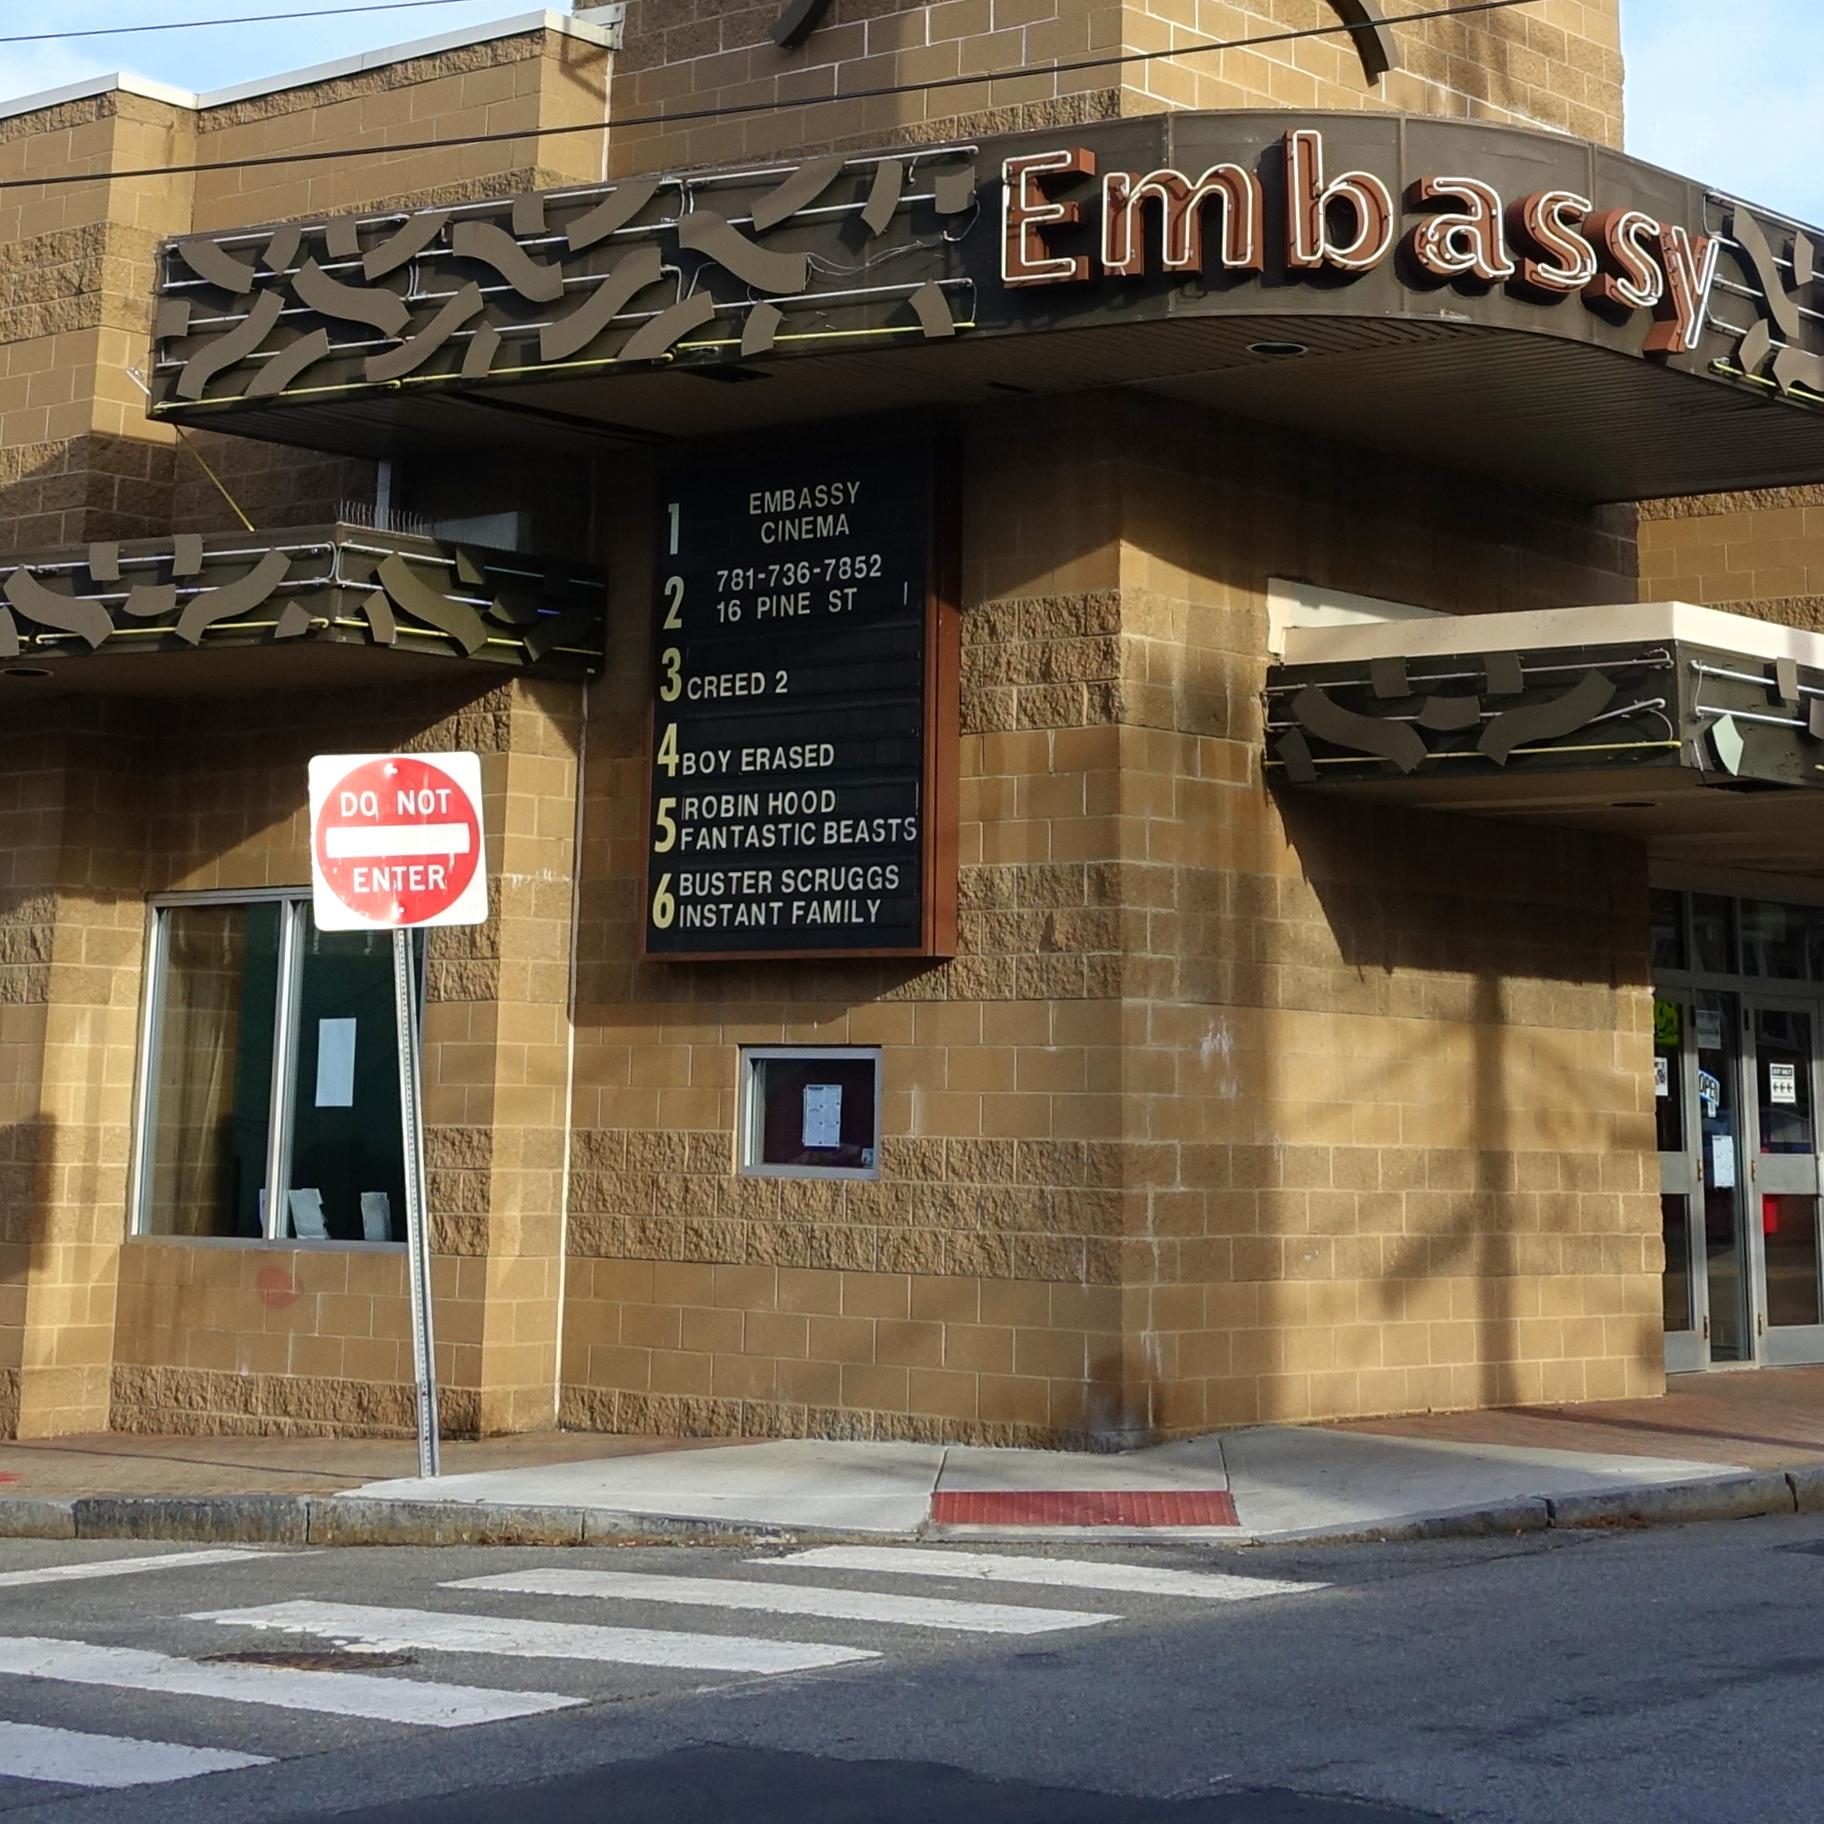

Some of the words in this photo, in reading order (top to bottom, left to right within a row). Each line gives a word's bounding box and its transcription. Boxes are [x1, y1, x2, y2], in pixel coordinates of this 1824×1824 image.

[1001, 129, 1721, 356] Embassy
[749, 481, 860, 515] EMBASSY
[668, 502, 680, 555] 1
[760, 513, 850, 544] CINEMA
[716, 554, 882, 593] 781-736-7852
[662, 576, 685, 630] 2
[716, 599, 742, 623] 16
[756, 591, 811, 619] PINE
[828, 587, 858, 613] ST
[659, 647, 683, 702] 3
[687, 671, 766, 700] CREED
[775, 670, 788, 693] 2
[657, 723, 679, 777] 4
[682, 750, 731, 776] BOY
[740, 743, 835, 772] ERASED
[340, 791, 378, 817] DO
[397, 789, 451, 815] NOT
[684, 793, 759, 821] ROBIN
[768, 789, 836, 816] HOOD
[654, 797, 677, 853] 5
[680, 822, 816, 851] FANTASTIC
[823, 816, 918, 845] BEASTS
[352, 864, 446, 893] ENTER
[679, 870, 773, 896] BUSTER
[781, 865, 900, 894] SCRUGGS
[652, 873, 675, 928] 6
[679, 901, 783, 928] INSTANT
[791, 899, 881, 924] FAMILY
